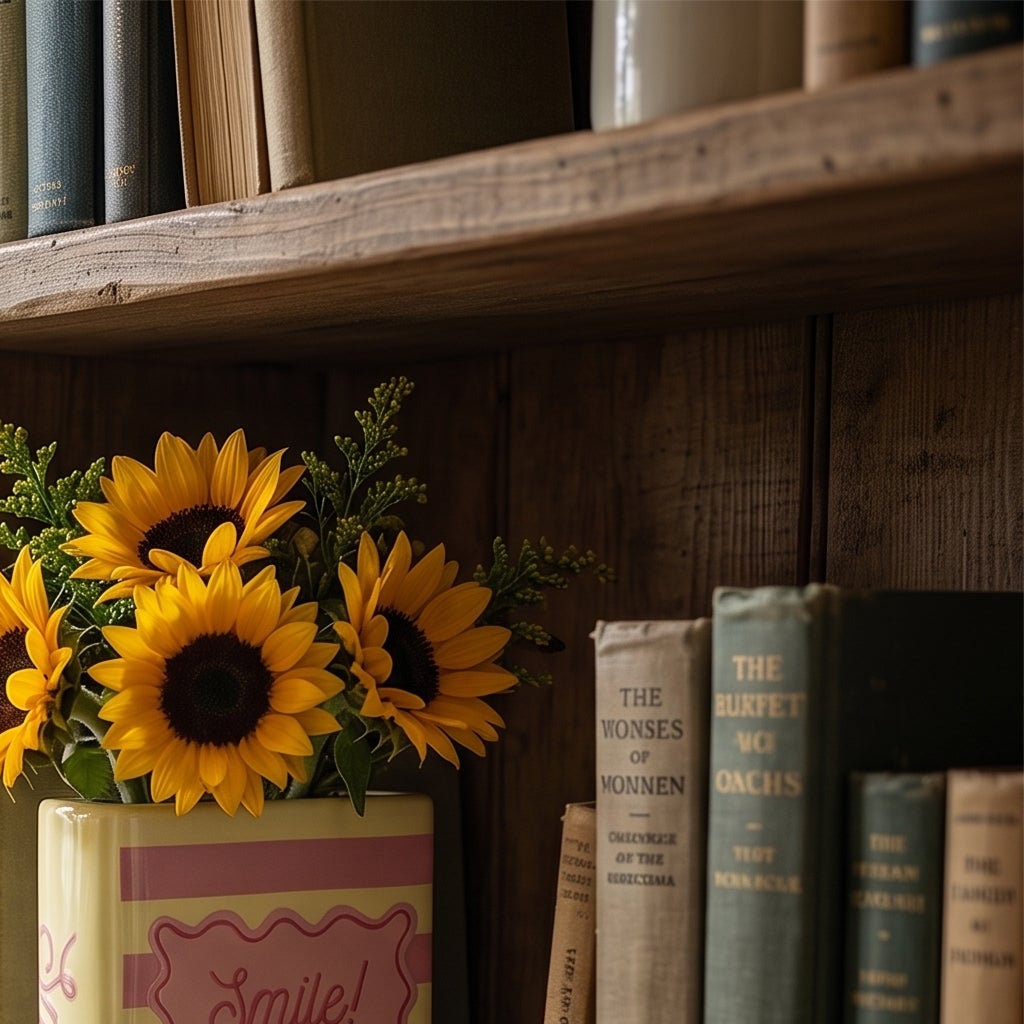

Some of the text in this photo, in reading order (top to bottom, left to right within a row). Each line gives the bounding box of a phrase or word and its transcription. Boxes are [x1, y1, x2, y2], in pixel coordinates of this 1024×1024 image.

[732, 654, 784, 682] THE
[619, 687, 663, 708] THE
[601, 718, 685, 740] WONSES
[629, 750, 651, 764] OF
